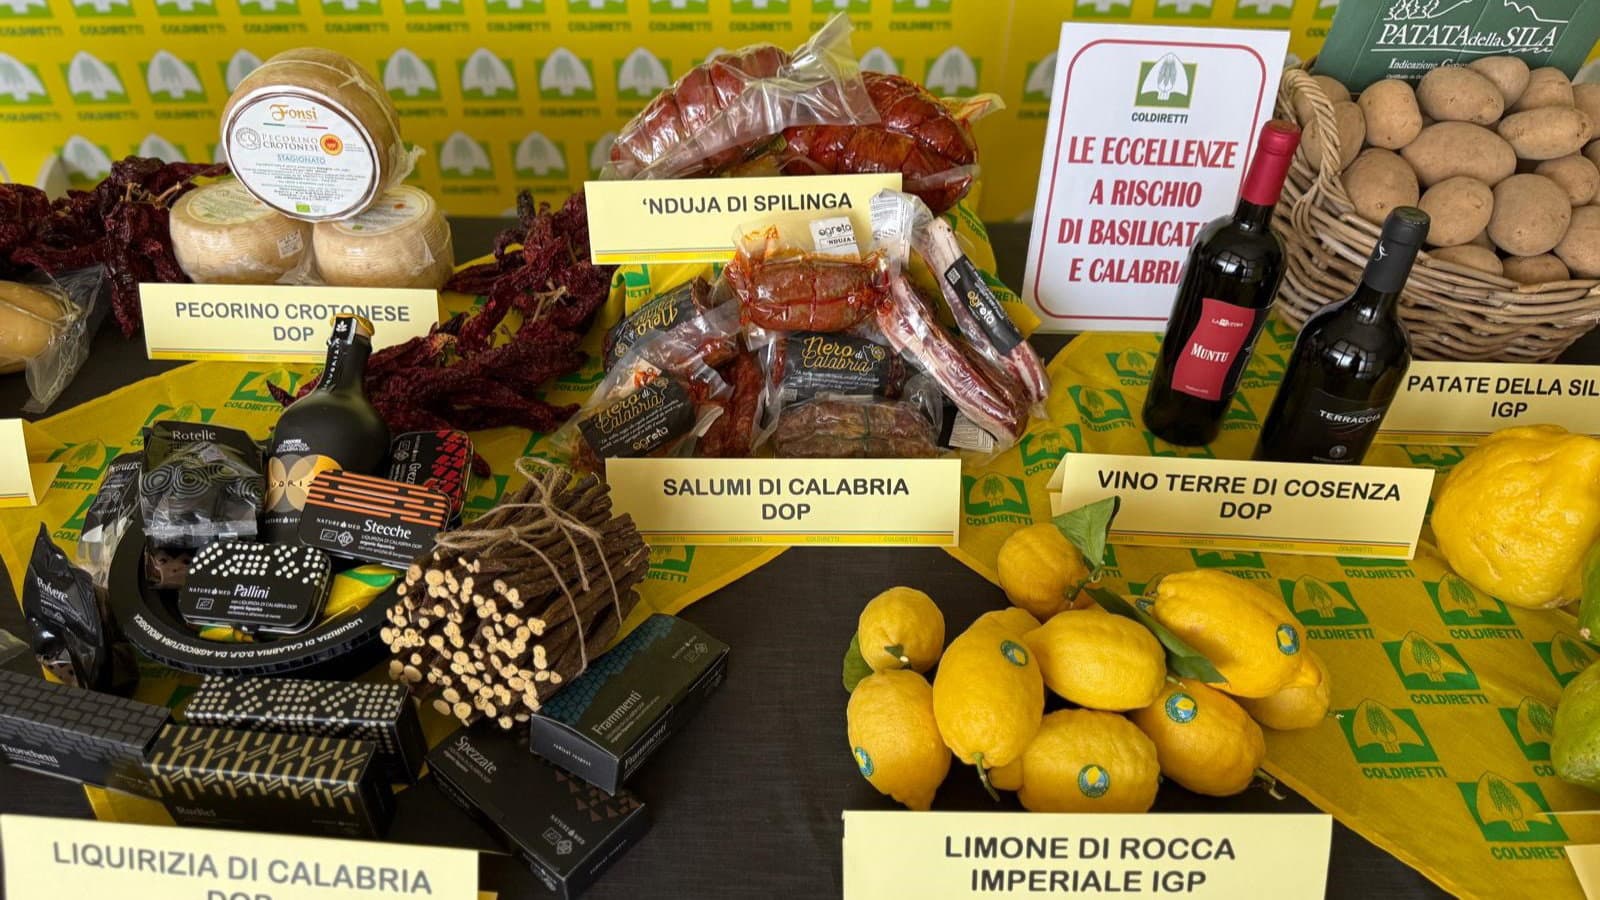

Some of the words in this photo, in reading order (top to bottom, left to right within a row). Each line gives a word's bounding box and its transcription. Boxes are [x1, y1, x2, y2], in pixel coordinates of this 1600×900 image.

[1131, 112, 1188, 124] COLDIRETTI
[262, 132, 318, 144] PECORINO
[262, 140, 320, 152] CROTONESE
[277, 153, 326, 165] STAGIONATO
[1068, 136, 1096, 165] LE
[1101, 137, 1239, 169] ECCELLENZE
[727, 196, 748, 212] DI
[754, 192, 852, 212] SPILINGA
[1089, 179, 1104, 206] A
[1111, 180, 1203, 208] RISCHIO
[1058, 218, 1083, 245] DI
[1088, 219, 1209, 248] BASILICAT
[1068, 258, 1084, 283] E
[175, 302, 279, 320] PECORINO
[273, 326, 315, 342] DOP
[803, 335, 855, 356] Nero
[1190, 343, 1230, 363] MUNTU
[802, 351, 873, 374] Calabria
[1407, 376, 1489, 394] PATATE
[1495, 377, 1562, 397] DELLA
[1491, 401, 1528, 418] IGP
[172, 429, 217, 441] Rotelle
[50, 481, 93, 491] DIRETTI
[663, 478, 751, 496] SALUMI
[759, 478, 782, 496] DI
[788, 478, 910, 496] CALABRIA
[1097, 469, 1158, 491] VINO
[1165, 474, 1246, 495] TERRE
[1254, 477, 1277, 496] DI
[1284, 479, 1401, 502] COSENZA
[761, 503, 811, 521] DOP
[1219, 501, 1272, 521] DOP
[362, 518, 412, 540] Stecche
[965, 516, 1034, 528] COLDIRETTI
[644, 570, 688, 584] IRETTI
[1344, 567, 1416, 580] COLDIRETTI
[233, 583, 272, 599] Pallini
[316, 617, 363, 642] LIQUIRIZIA
[1450, 628, 1525, 640] COLDIRETTI
[161, 636, 212, 657] AGRICOLTURA
[257, 641, 304, 657] CALABRIA
[305, 638, 316, 648] DI
[215, 650, 229, 658] DA
[1409, 693, 1489, 706] COLDIRETTI
[591, 690, 643, 736] Frammenti
[454, 735, 497, 776] Spezzate
[1362, 765, 1449, 780] COLDIRETTI
[944, 836, 1069, 860] LIMONE
[1079, 837, 1111, 860] DI
[1120, 836, 1236, 861] ROCCA
[1490, 846, 1566, 860] COLDIRET
[53, 841, 218, 879] LIQUIRIZIA
[228, 855, 258, 882] DI
[268, 859, 433, 896] CALABRIA
[971, 869, 1142, 893] IMPERIALE
[1151, 869, 1207, 893] IGP
